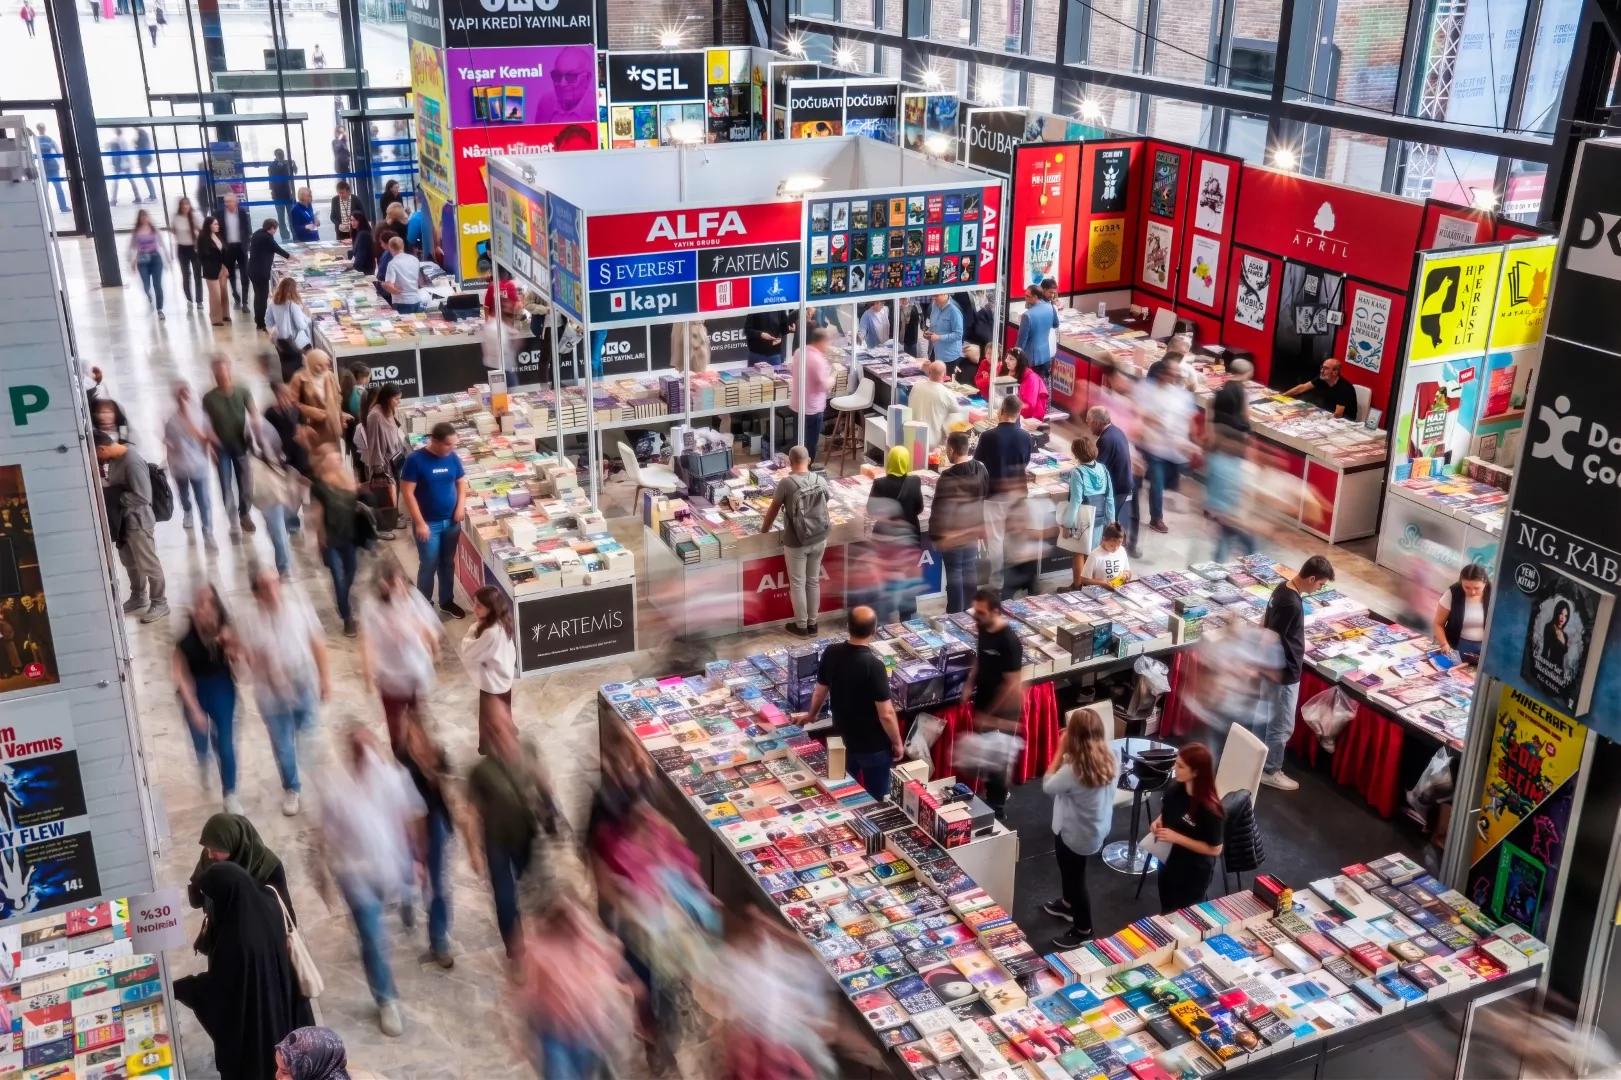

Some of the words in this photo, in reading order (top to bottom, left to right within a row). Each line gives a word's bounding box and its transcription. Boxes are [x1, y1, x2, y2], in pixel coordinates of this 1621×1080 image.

[449, 18, 479, 30] YAPI
[483, 14, 522, 30] KREDİ
[524, 15, 591, 28] YAYINLARI
[458, 67, 496, 82] Yaşar
[500, 64, 543, 78] Kemal
[792, 95, 843, 109] DOĞUBATI
[846, 93, 896, 107] DOĞUBATI
[462, 143, 504, 158] Nâzım
[463, 221, 491, 235] Sab
[646, 210, 748, 243] ALFA
[980, 205, 997, 267] ALFA
[673, 240, 695, 248] YAYIN
[696, 238, 721, 246] GRUBU
[1292, 233, 1349, 258] APRIL
[725, 248, 790, 273] ARTEMİS
[1249, 261, 1264, 273] ADAM
[631, 290, 678, 314] kapı
[1358, 296, 1370, 306] HAN
[1370, 299, 1388, 311] KANG
[614, 352, 646, 362] YAYINLARI
[8, 384, 50, 426] P
[1517, 523, 1559, 561] N.G.
[1565, 542, 1621, 586] KAB
[756, 564, 831, 594] ALA
[1518, 575, 1536, 590] KİTAP
[1520, 564, 1536, 578] YENİ
[547, 609, 623, 640] ARTEMİS
[1510, 689, 1575, 738] MINECRAFT
[4, 736, 64, 760] Varmış
[1508, 736, 1544, 777] ZOR
[1498, 759, 1546, 805] SEÇİM
[20, 821, 65, 844] FLEW
[140, 905, 171, 920] %30
